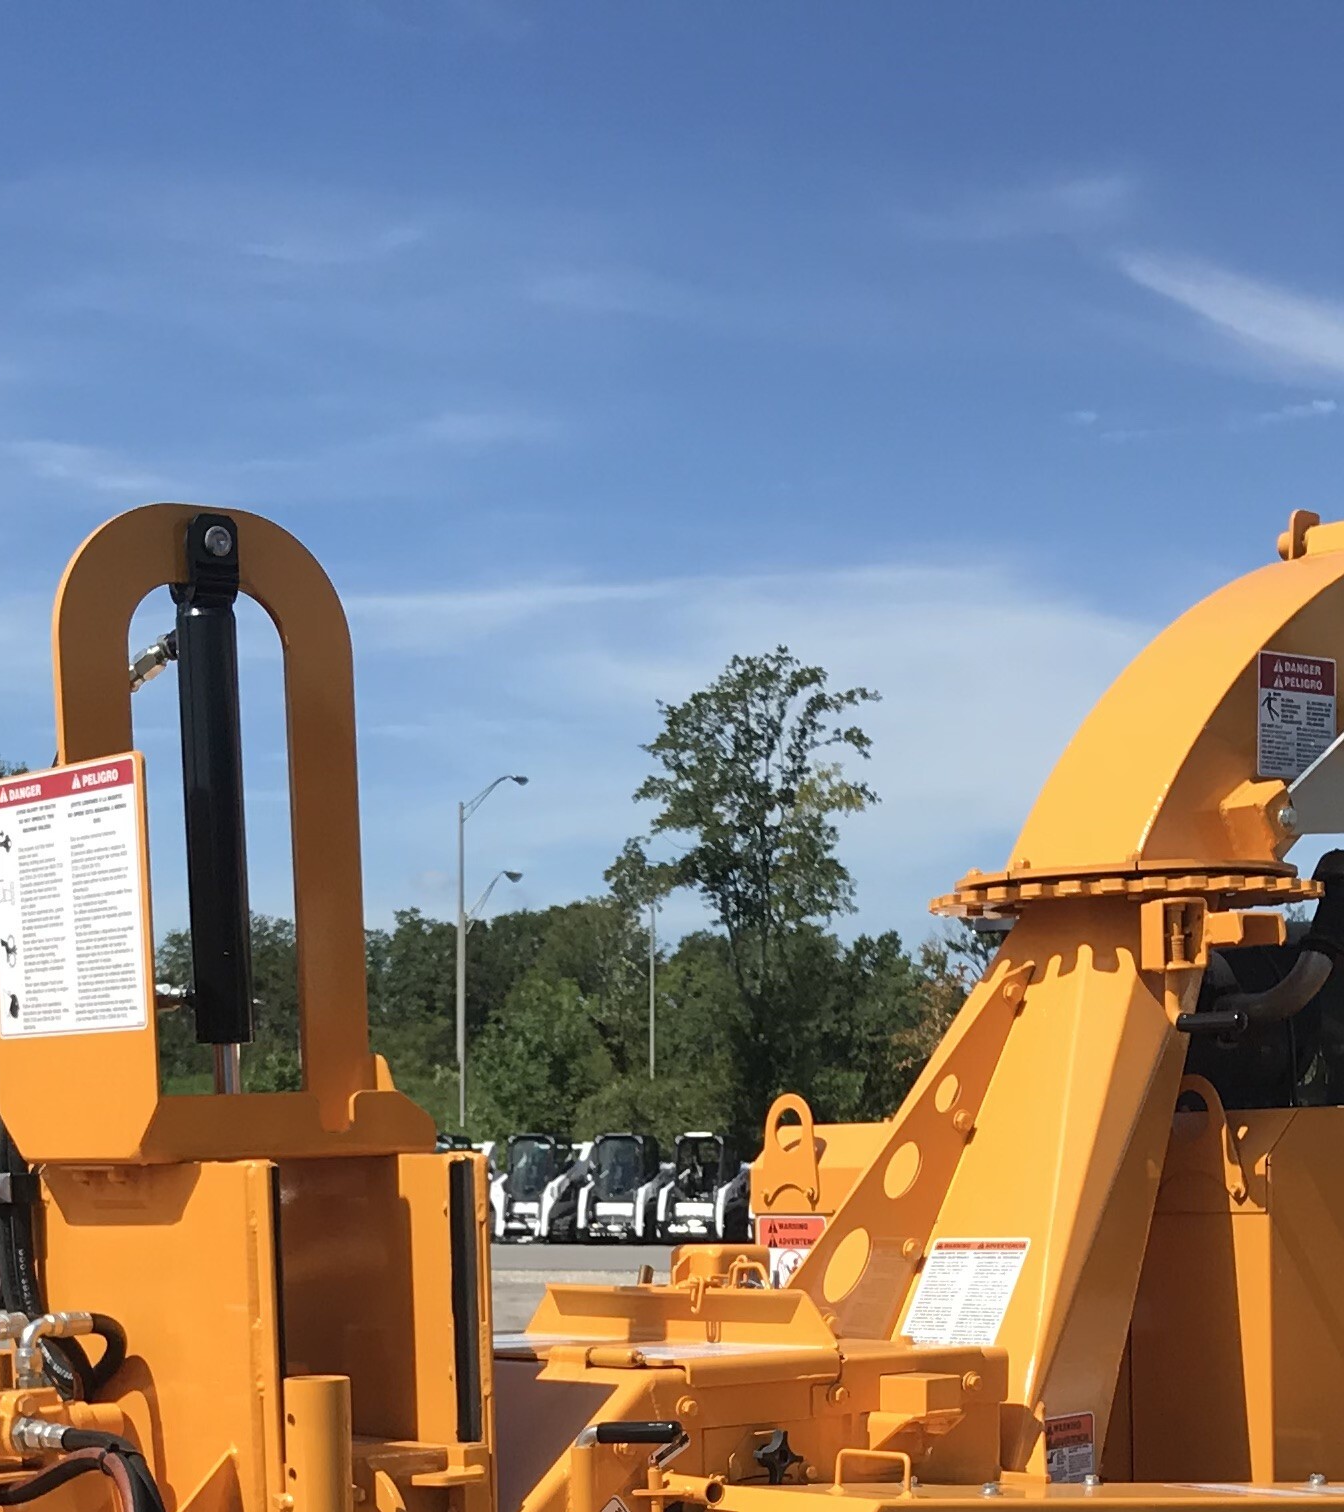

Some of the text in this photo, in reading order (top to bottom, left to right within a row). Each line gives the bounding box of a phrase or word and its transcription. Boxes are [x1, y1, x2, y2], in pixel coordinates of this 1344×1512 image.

[1285, 662, 1321, 675] DANGER
[1284, 676, 1323, 690] PELIGRO
[9, 768, 119, 801] DANGER PELIGRO
